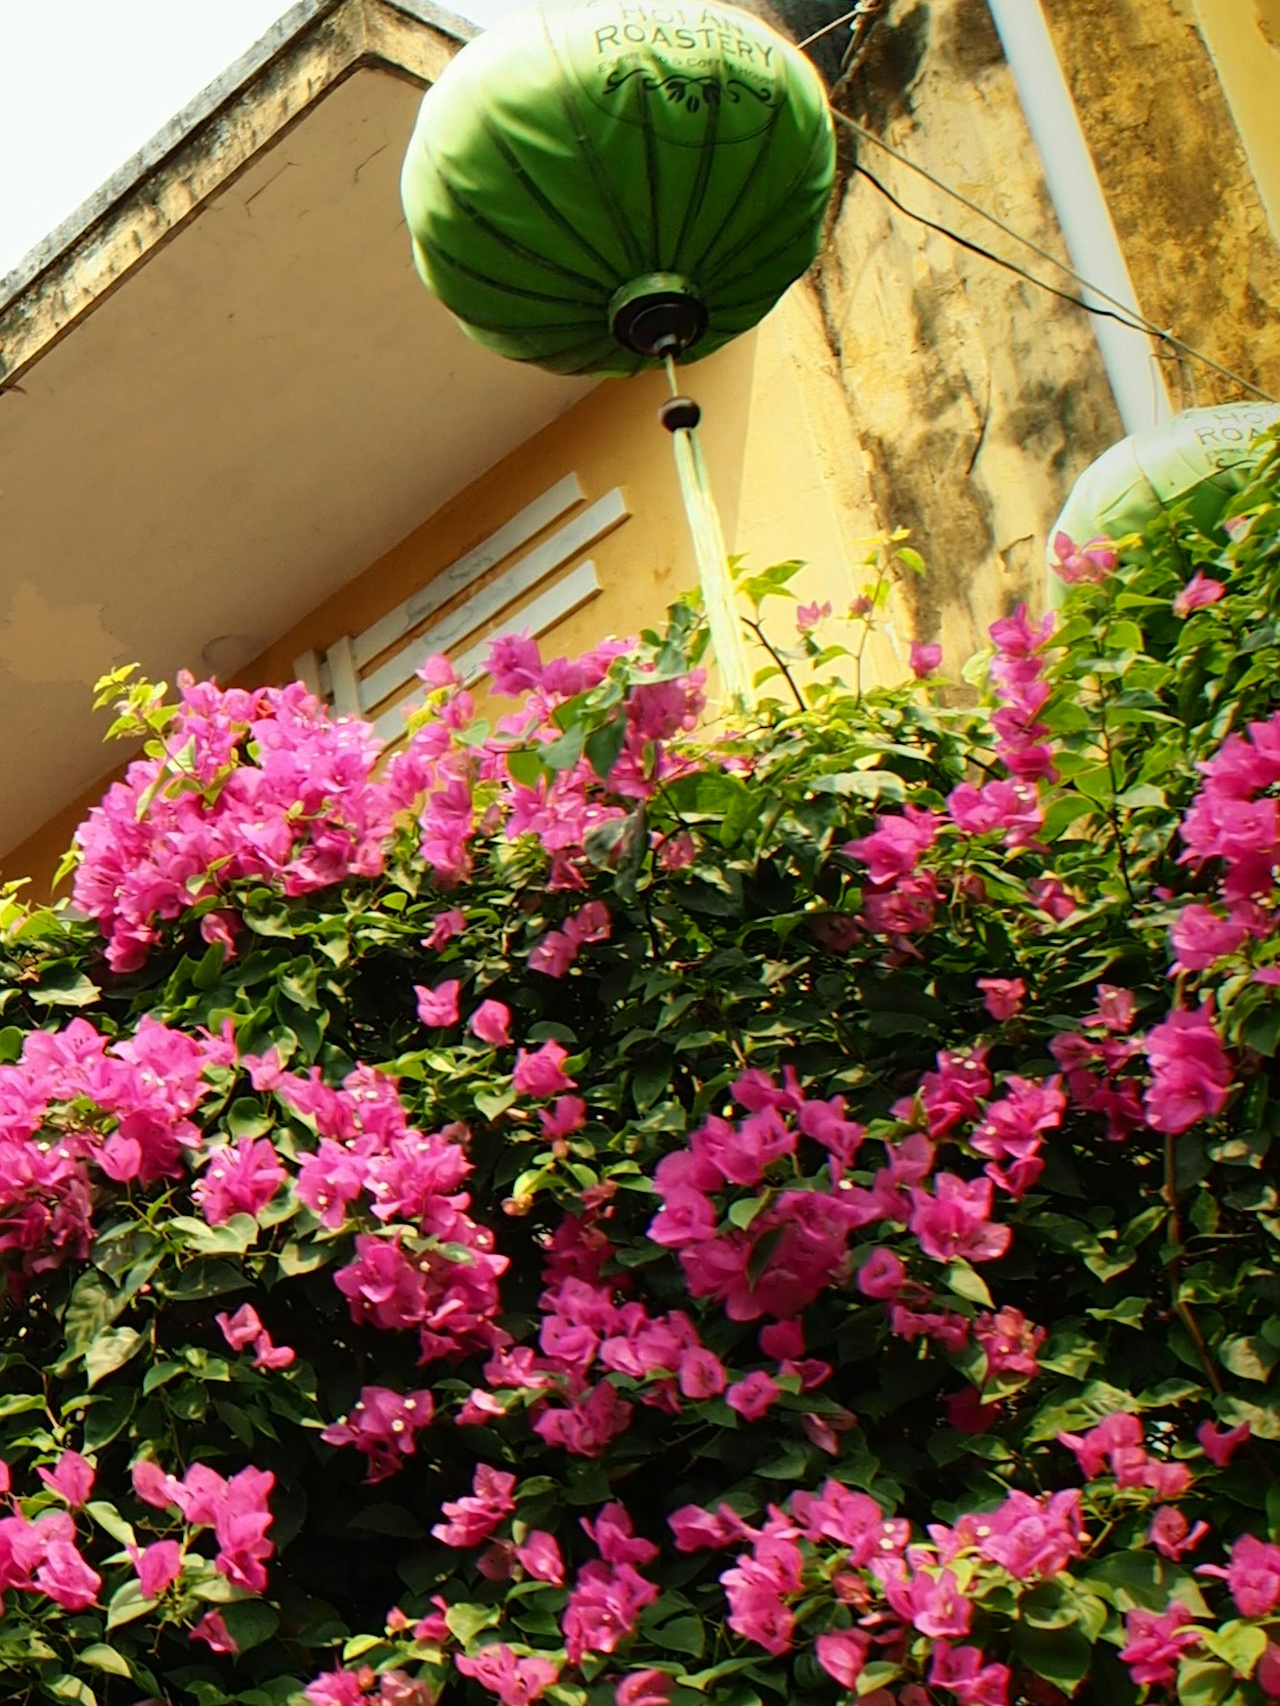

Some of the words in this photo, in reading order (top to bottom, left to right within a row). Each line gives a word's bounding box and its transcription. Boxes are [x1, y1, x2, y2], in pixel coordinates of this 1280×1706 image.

[620, 3, 686, 25] HOI
[701, 8, 744, 36] AN
[595, 24, 773, 67] ROASTERY
